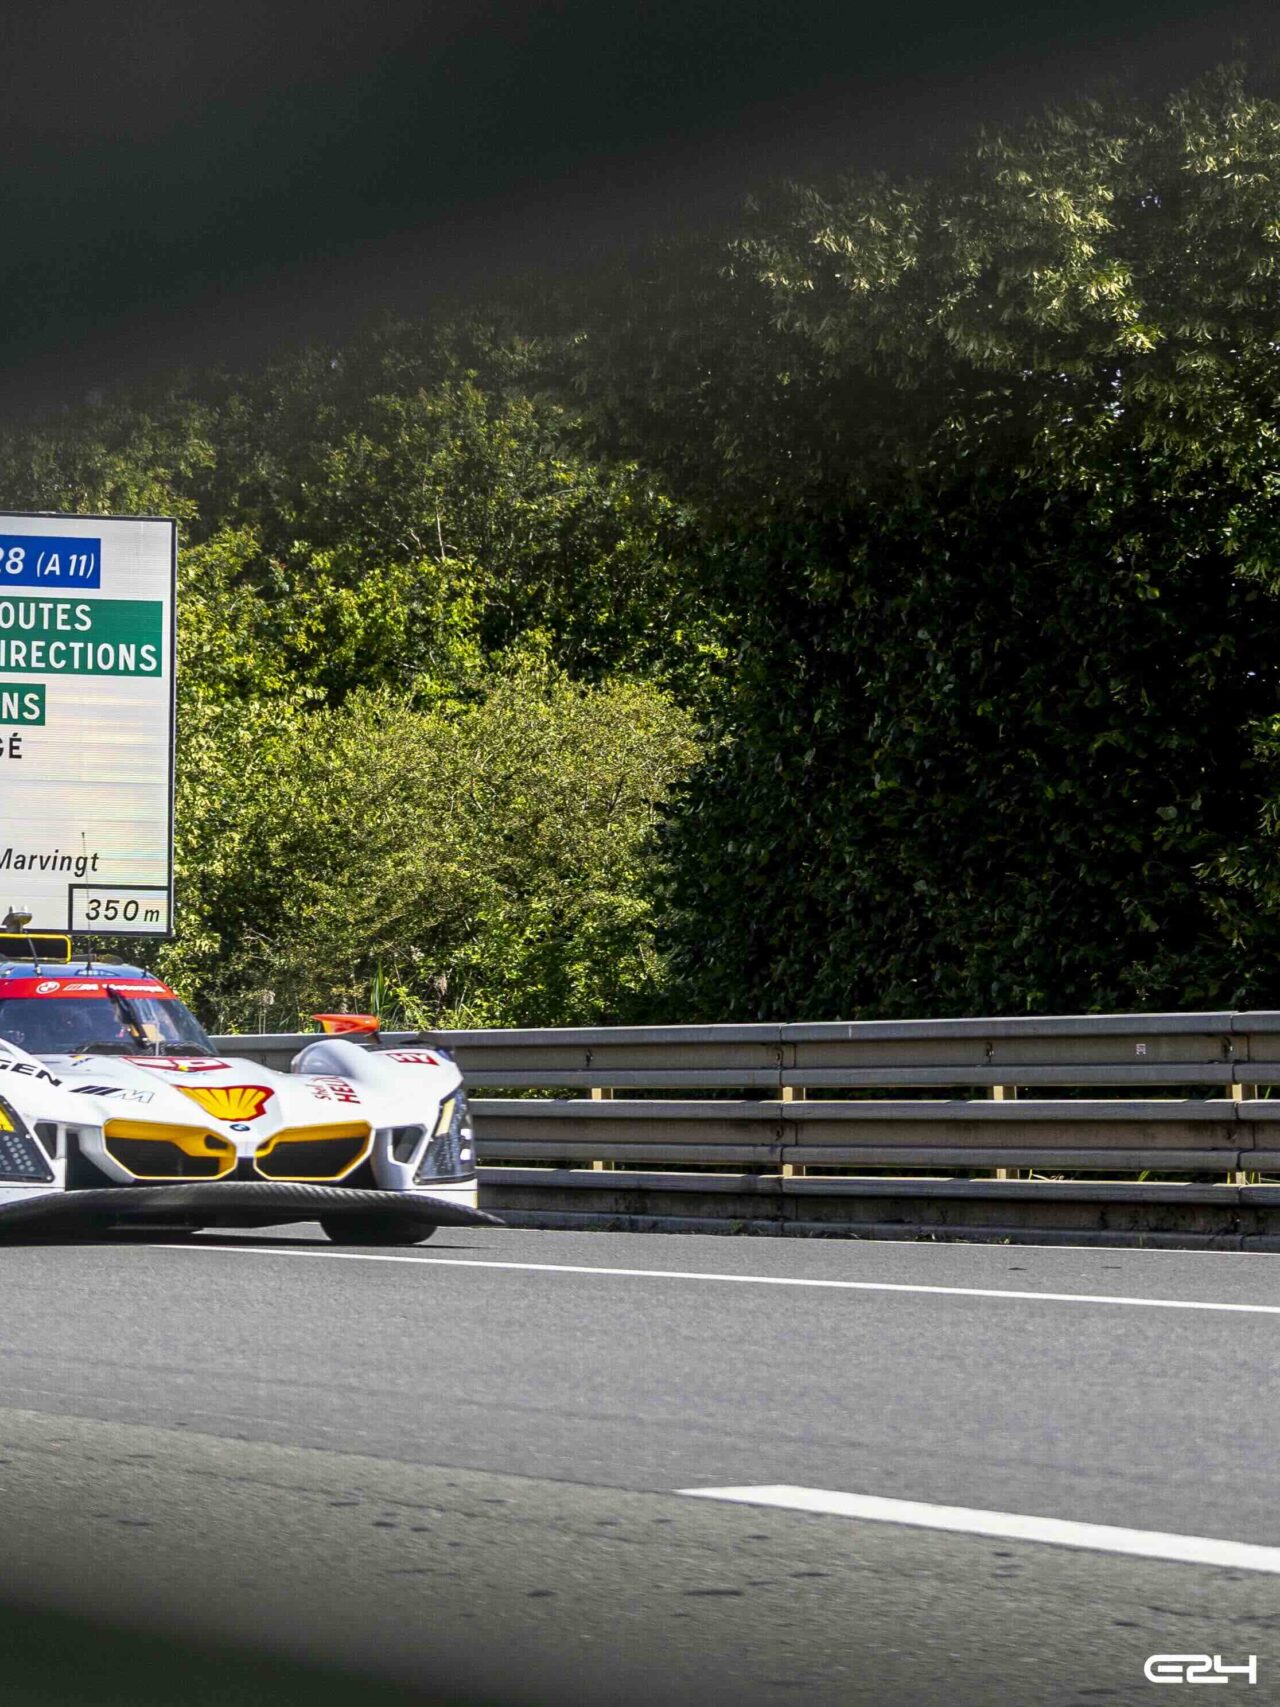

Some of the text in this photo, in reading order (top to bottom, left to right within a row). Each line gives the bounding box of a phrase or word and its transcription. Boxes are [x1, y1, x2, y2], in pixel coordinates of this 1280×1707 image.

[36, 551, 61, 578] (A
[68, 553, 96, 579] 11)
[85, 899, 140, 922] 350
